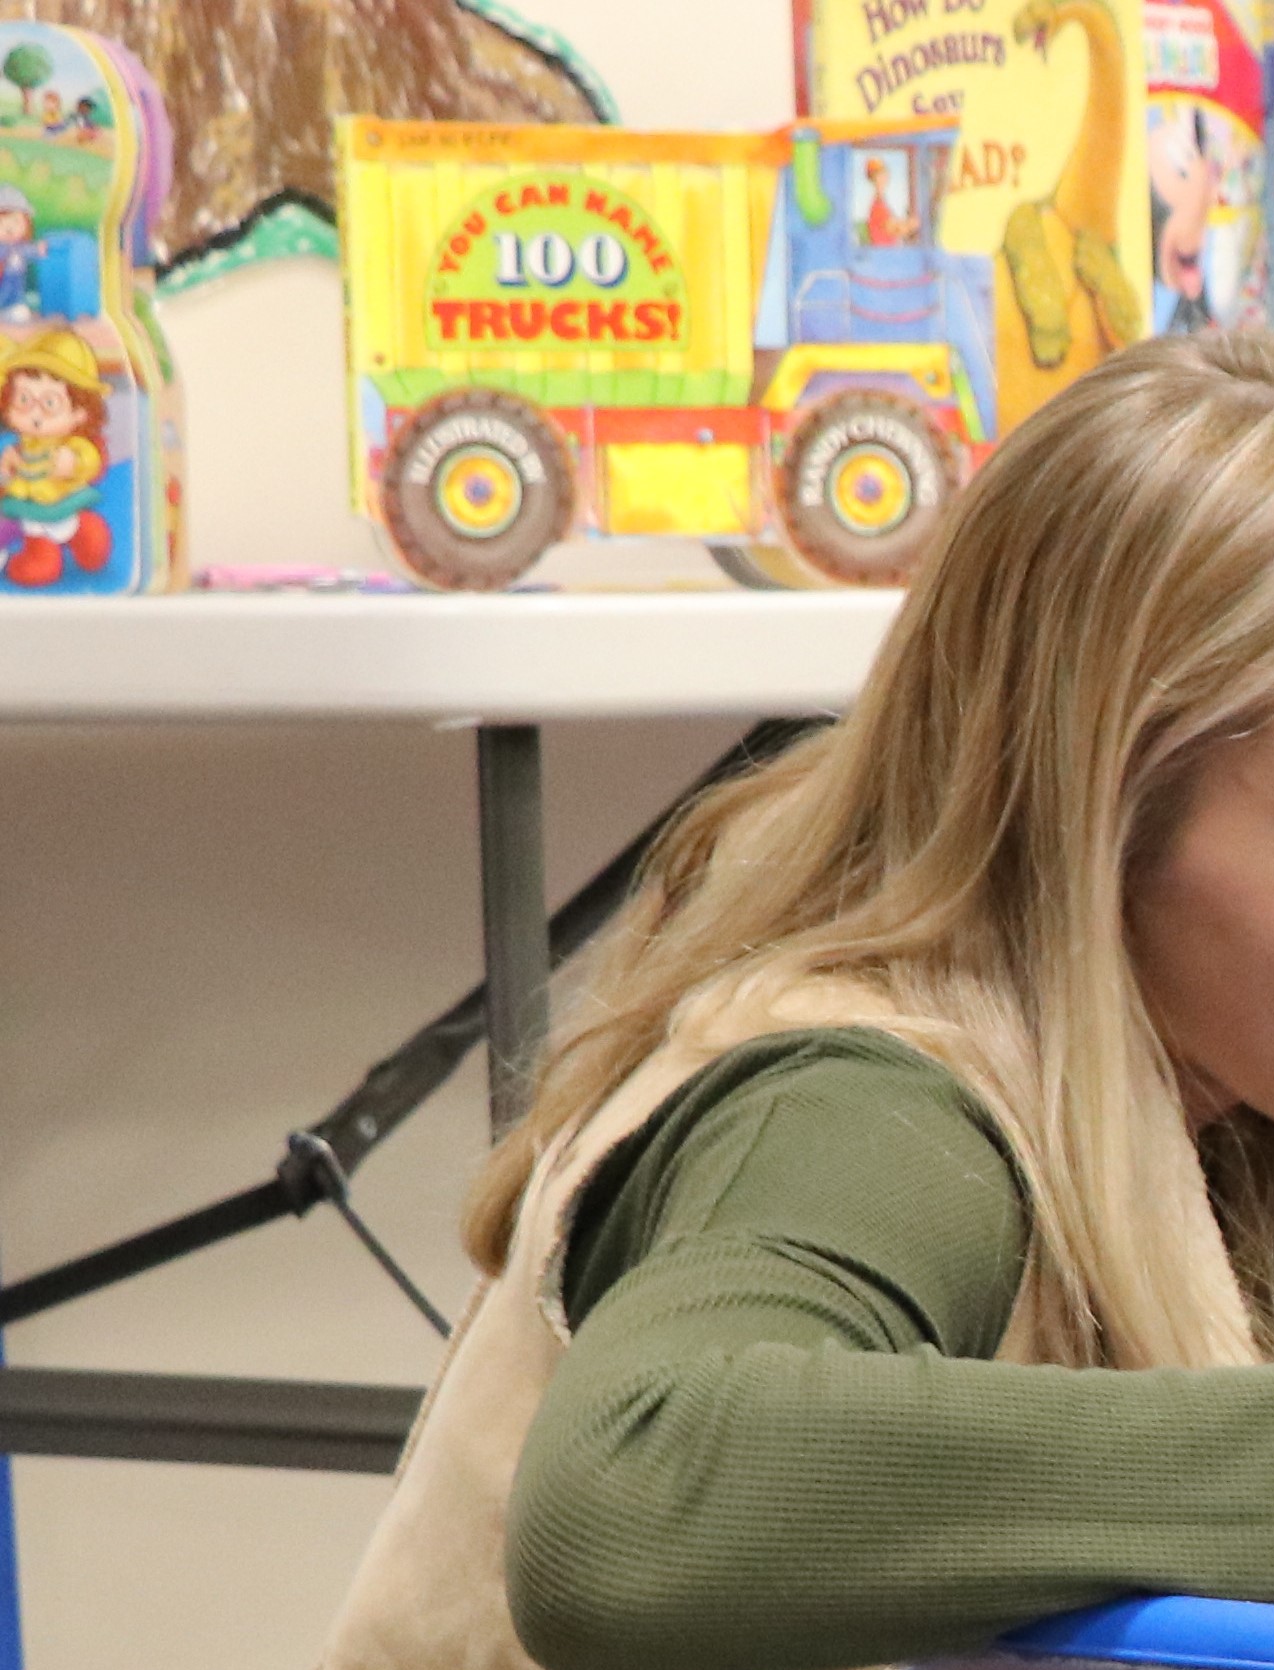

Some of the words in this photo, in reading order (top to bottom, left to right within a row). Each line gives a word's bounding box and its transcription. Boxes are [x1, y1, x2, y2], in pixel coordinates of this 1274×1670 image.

[438, 210, 487, 272] YOU
[493, 183, 570, 217] CAN
[584, 188, 675, 275] NAME
[493, 231, 628, 289] 100
[432, 299, 681, 342] TRUCKS!
